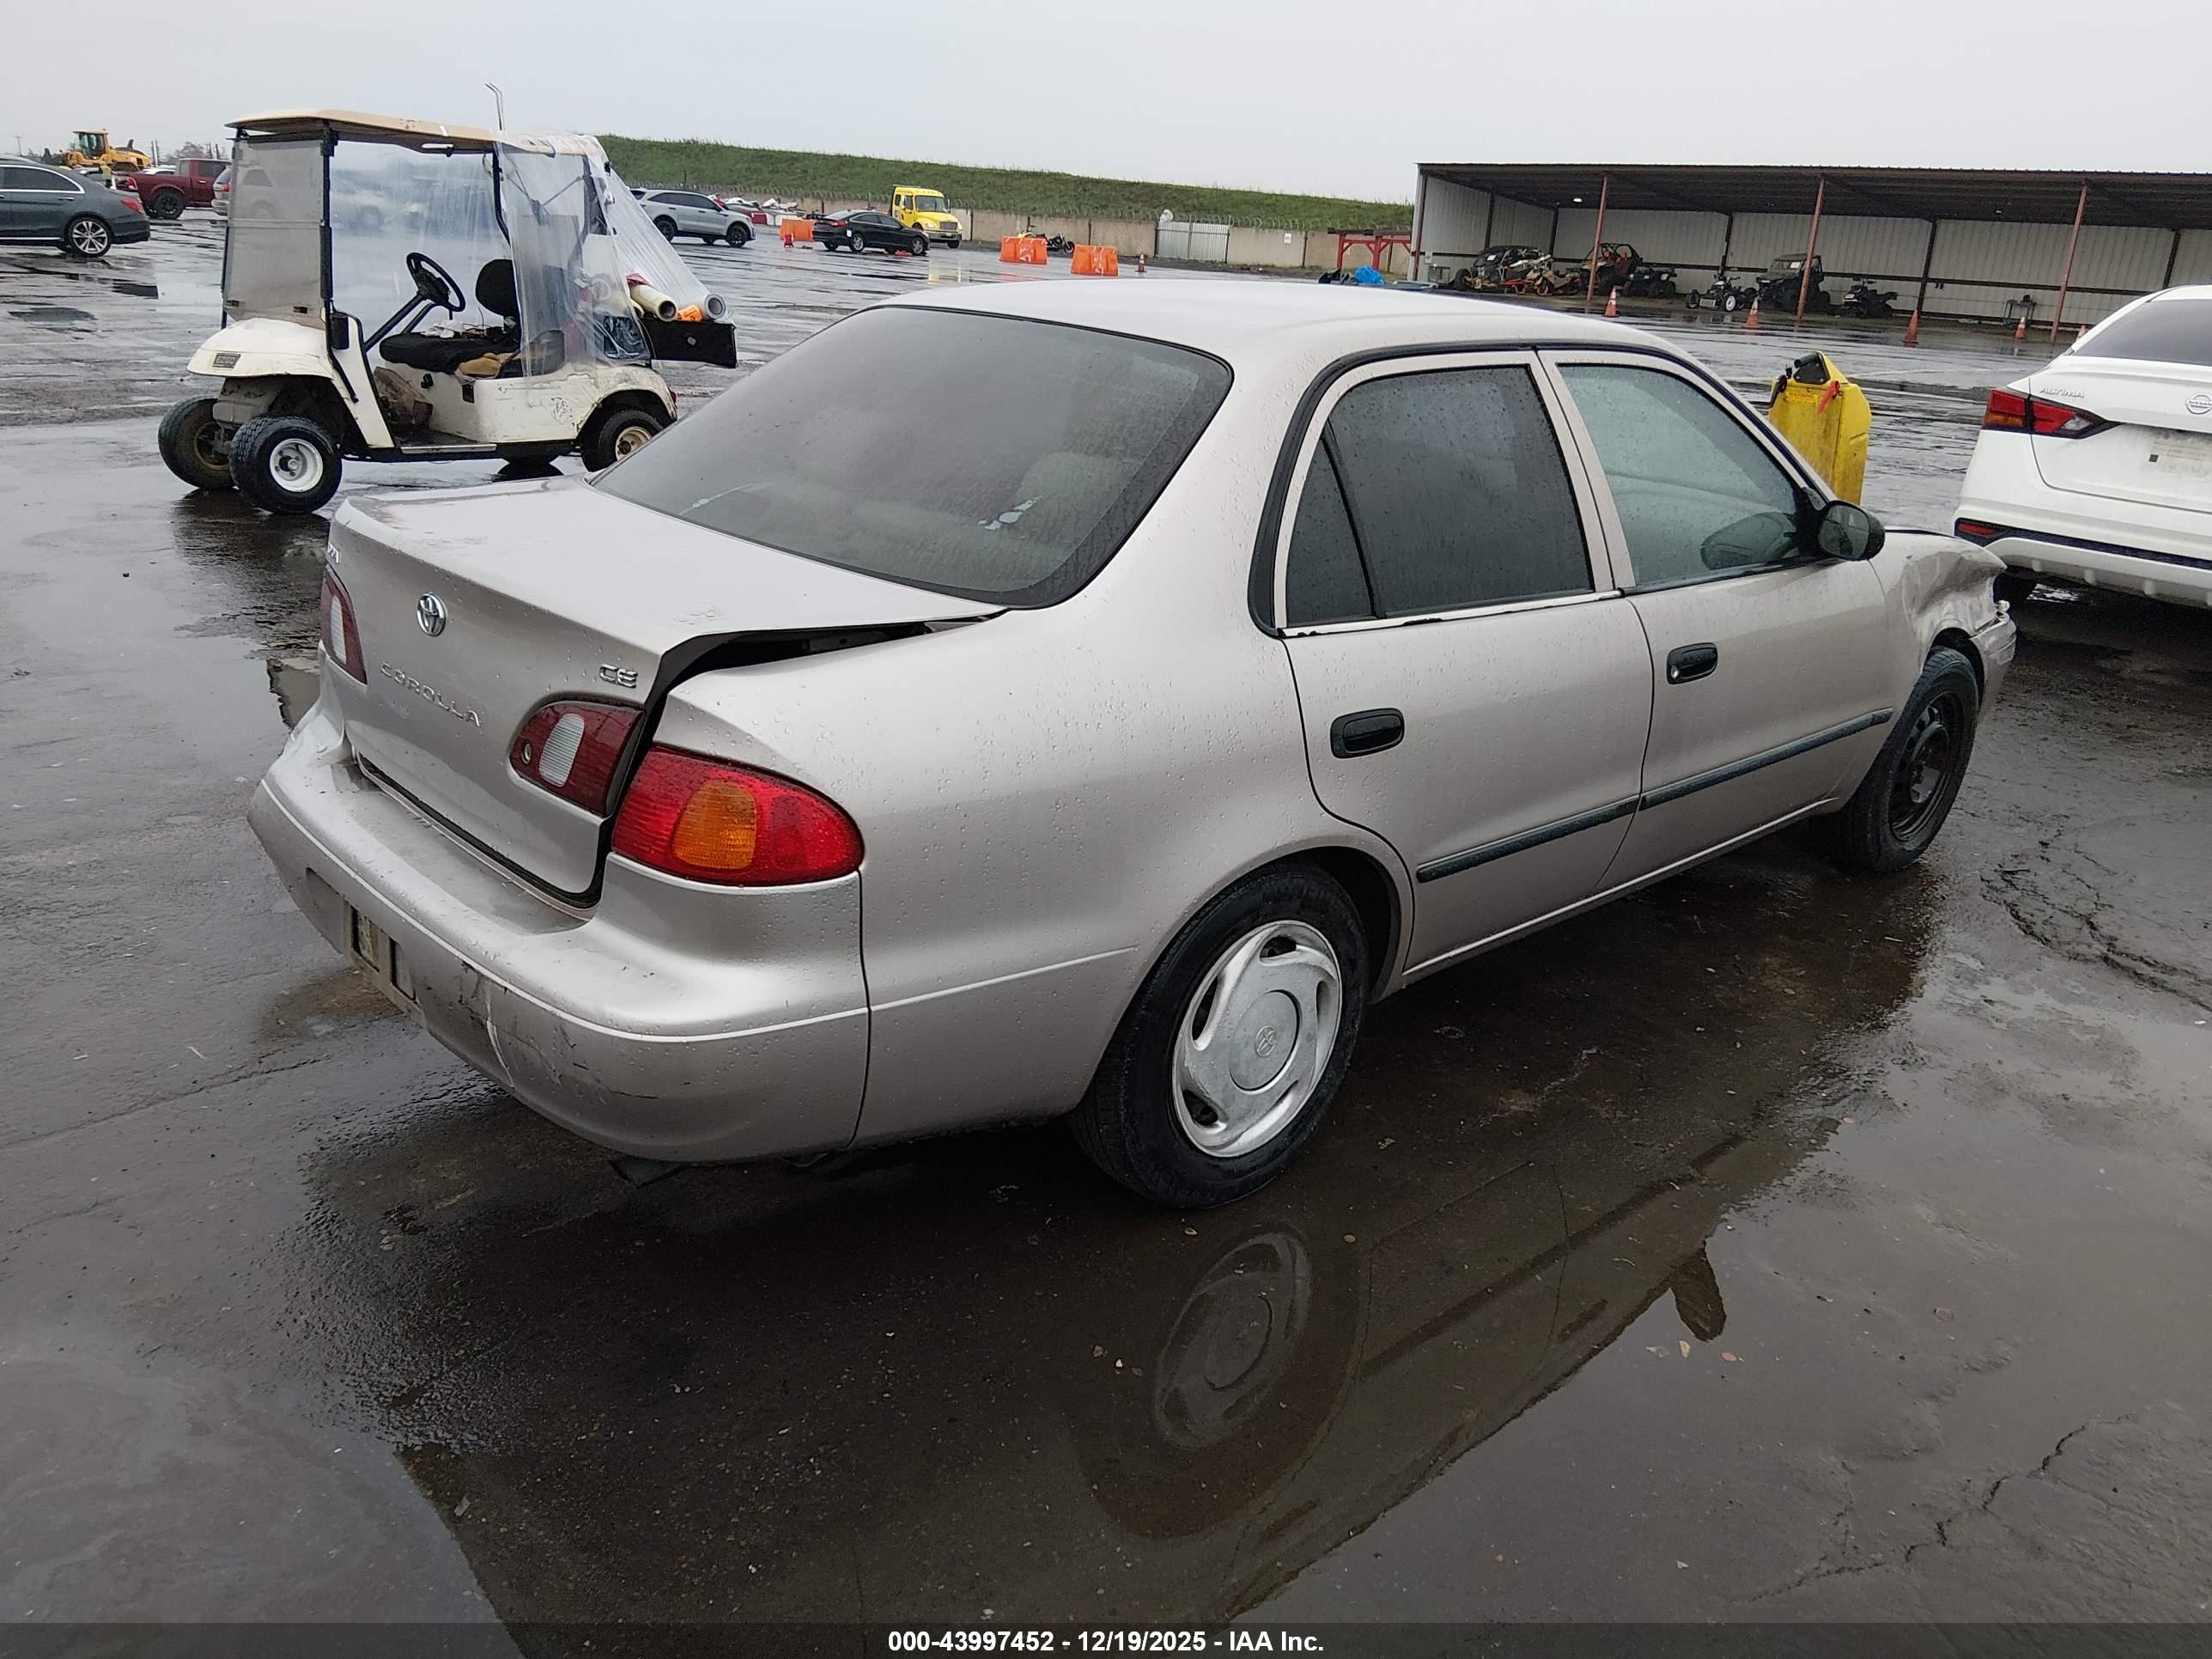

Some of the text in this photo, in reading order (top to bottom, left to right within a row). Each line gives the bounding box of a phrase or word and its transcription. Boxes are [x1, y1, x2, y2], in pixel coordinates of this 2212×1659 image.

[2040, 386, 2085, 398] ALTIMA
[599, 663, 638, 688] CE
[380, 661, 481, 727] COROLLA
